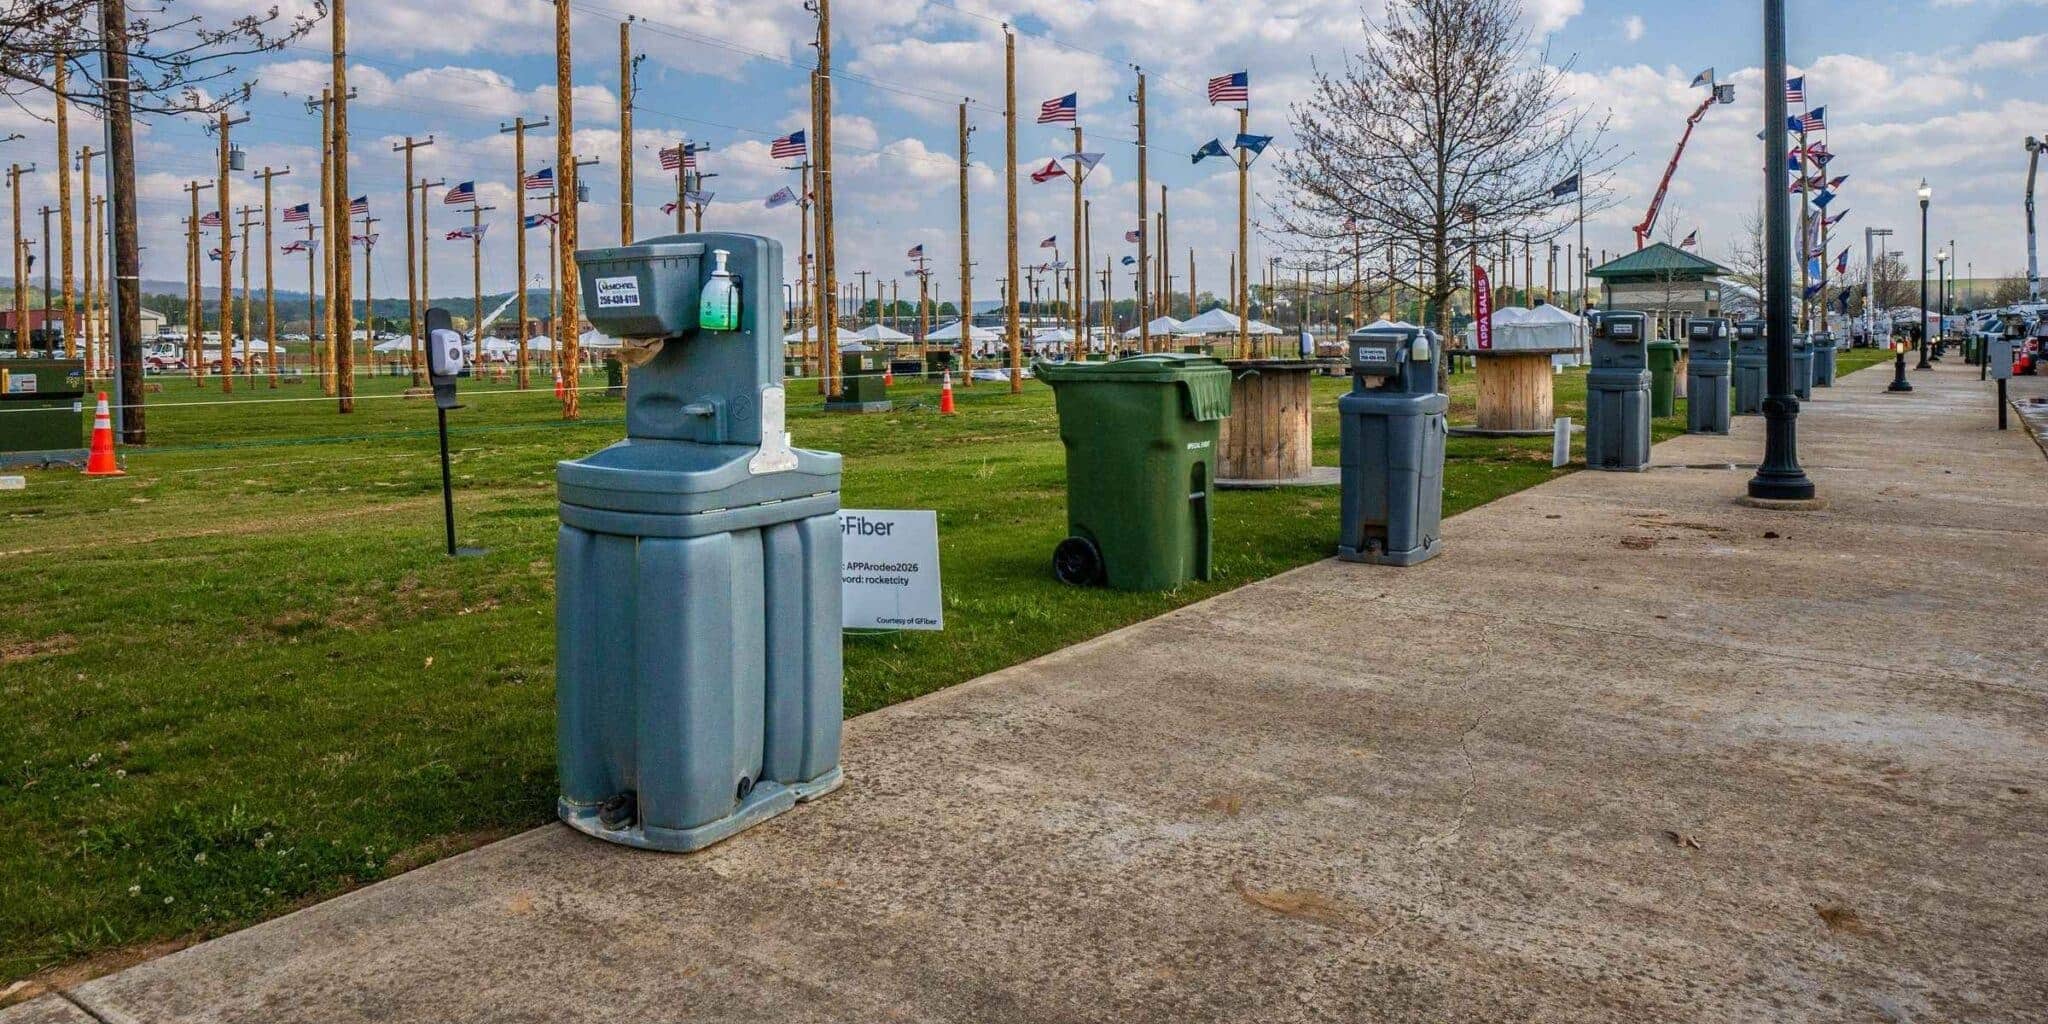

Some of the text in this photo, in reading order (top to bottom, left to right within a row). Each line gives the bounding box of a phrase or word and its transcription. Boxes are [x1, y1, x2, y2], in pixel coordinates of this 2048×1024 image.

[1479, 279, 1488, 347] APPA SALES
[846, 562, 919, 572] APPArodeo2026
[865, 575, 909, 586] rocketcity
[876, 617, 937, 625] Courtesy of GFiber
